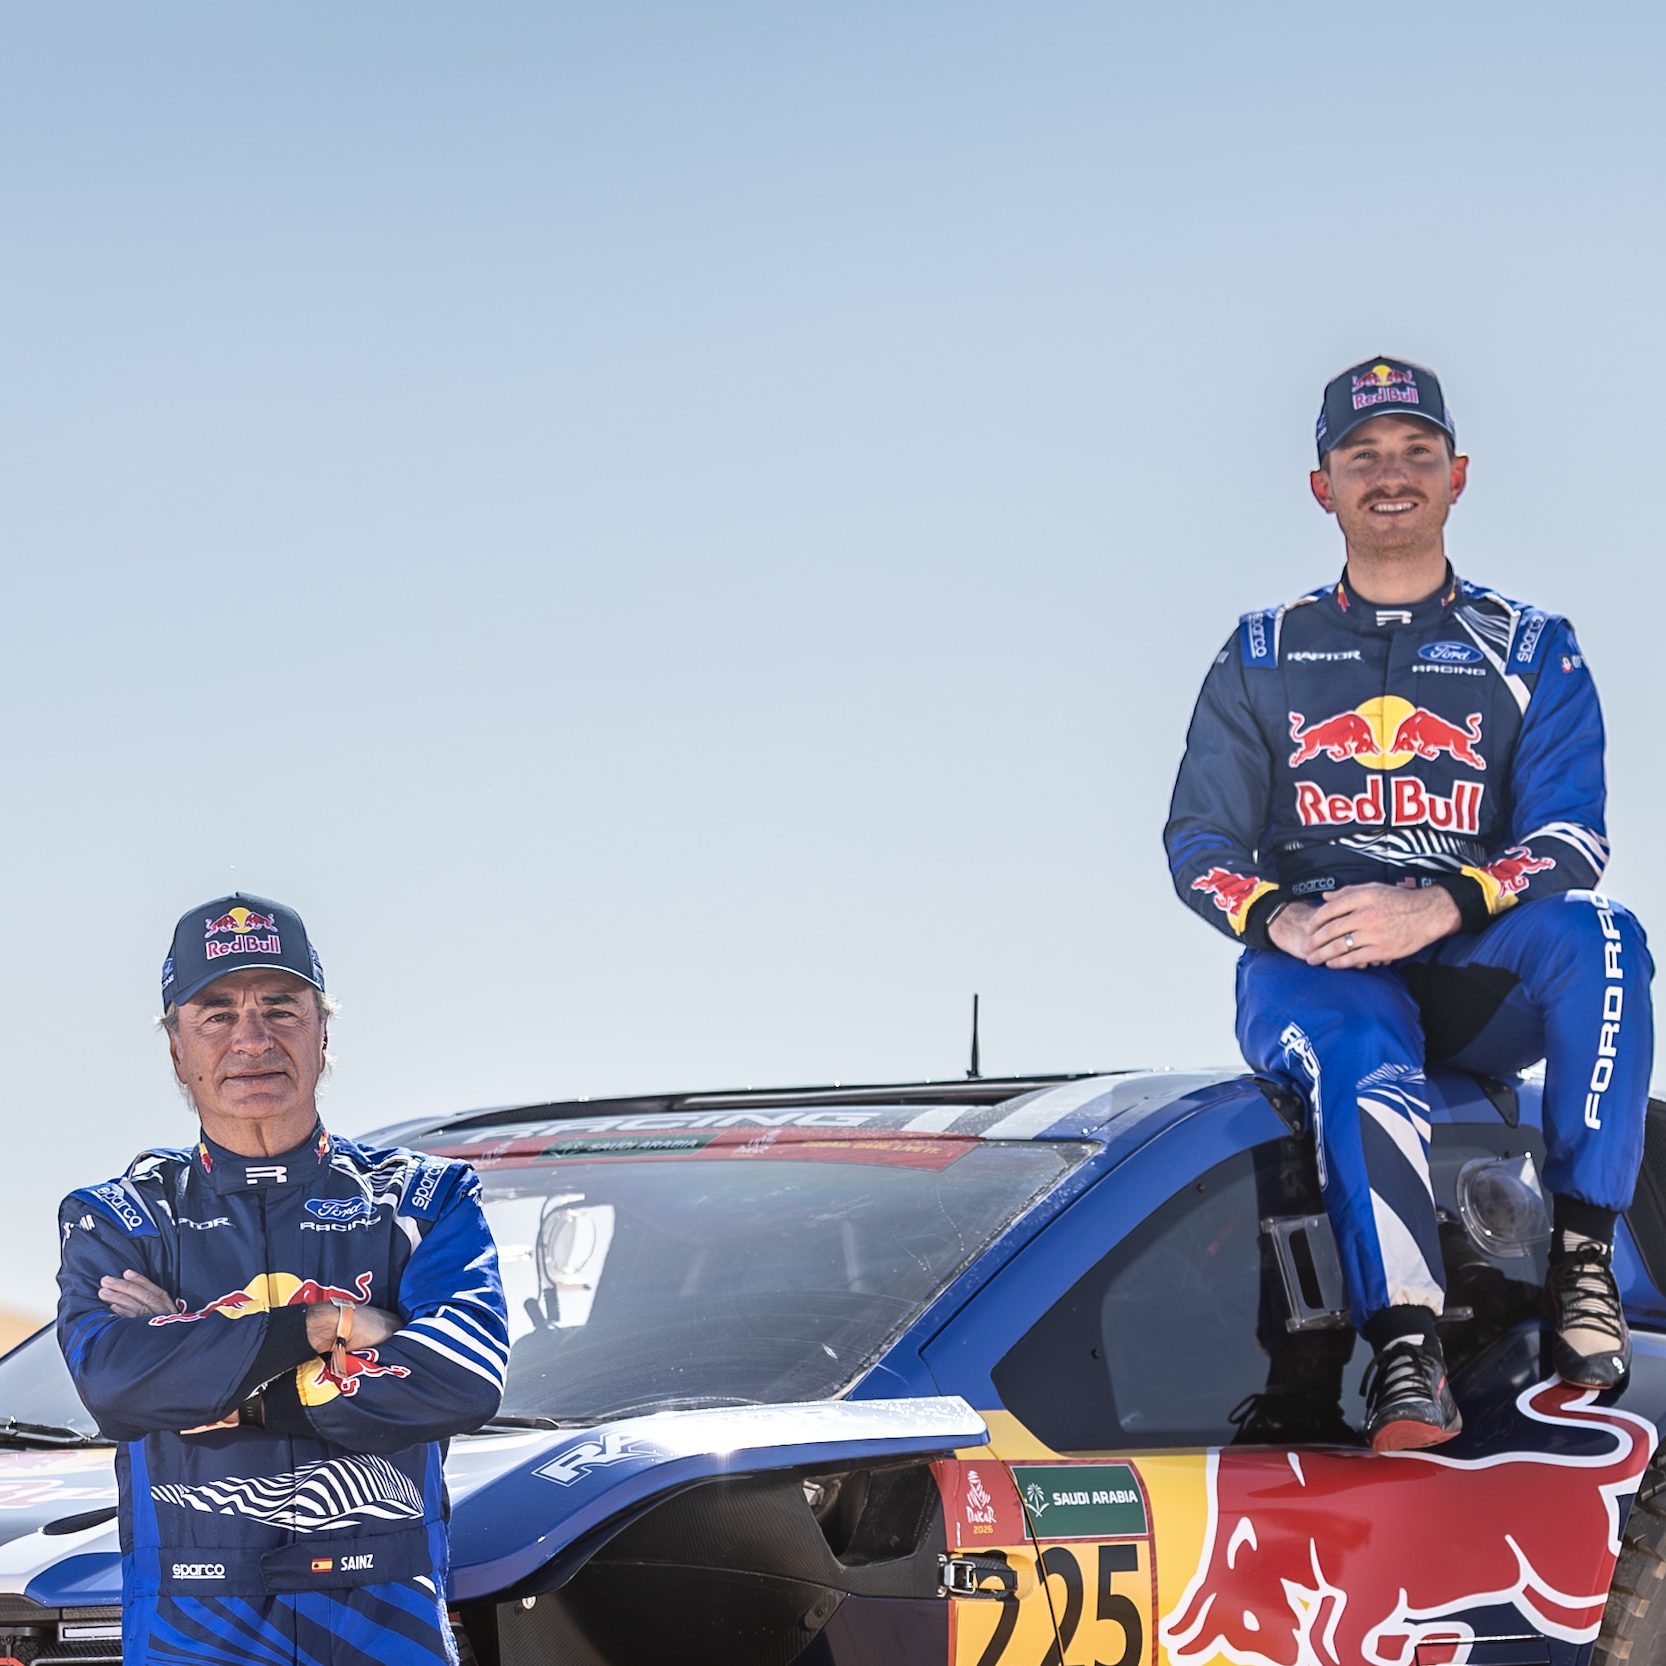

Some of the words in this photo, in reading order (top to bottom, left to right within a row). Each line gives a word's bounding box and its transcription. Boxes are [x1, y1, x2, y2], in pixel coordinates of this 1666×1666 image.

[1353, 387, 1386, 410] Red
[1387, 388, 1419, 404] Bull
[1287, 650, 1364, 663] RAPTOR
[1430, 645, 1469, 661] Ford
[1412, 665, 1486, 676] RACING
[1295, 775, 1386, 826] Red
[1391, 776, 1484, 835] Bull
[1292, 877, 1335, 895] sparco
[205, 935, 244, 960] Red
[244, 935, 281, 954] Bull
[1584, 985, 1623, 1130] FORD
[462, 1112, 883, 1144] RACING
[412, 1162, 447, 1210] sparco
[92, 1187, 142, 1231] sparco
[317, 1201, 363, 1218] Ford
[1053, 1491, 1090, 1506] SAUDI
[1092, 1489, 1139, 1505] ARABIA
[966, 1507, 997, 1524] DAKAR
[973, 1526, 994, 1534] 2026
[340, 1554, 374, 1571] SAINZ
[172, 1563, 225, 1580] sparco
